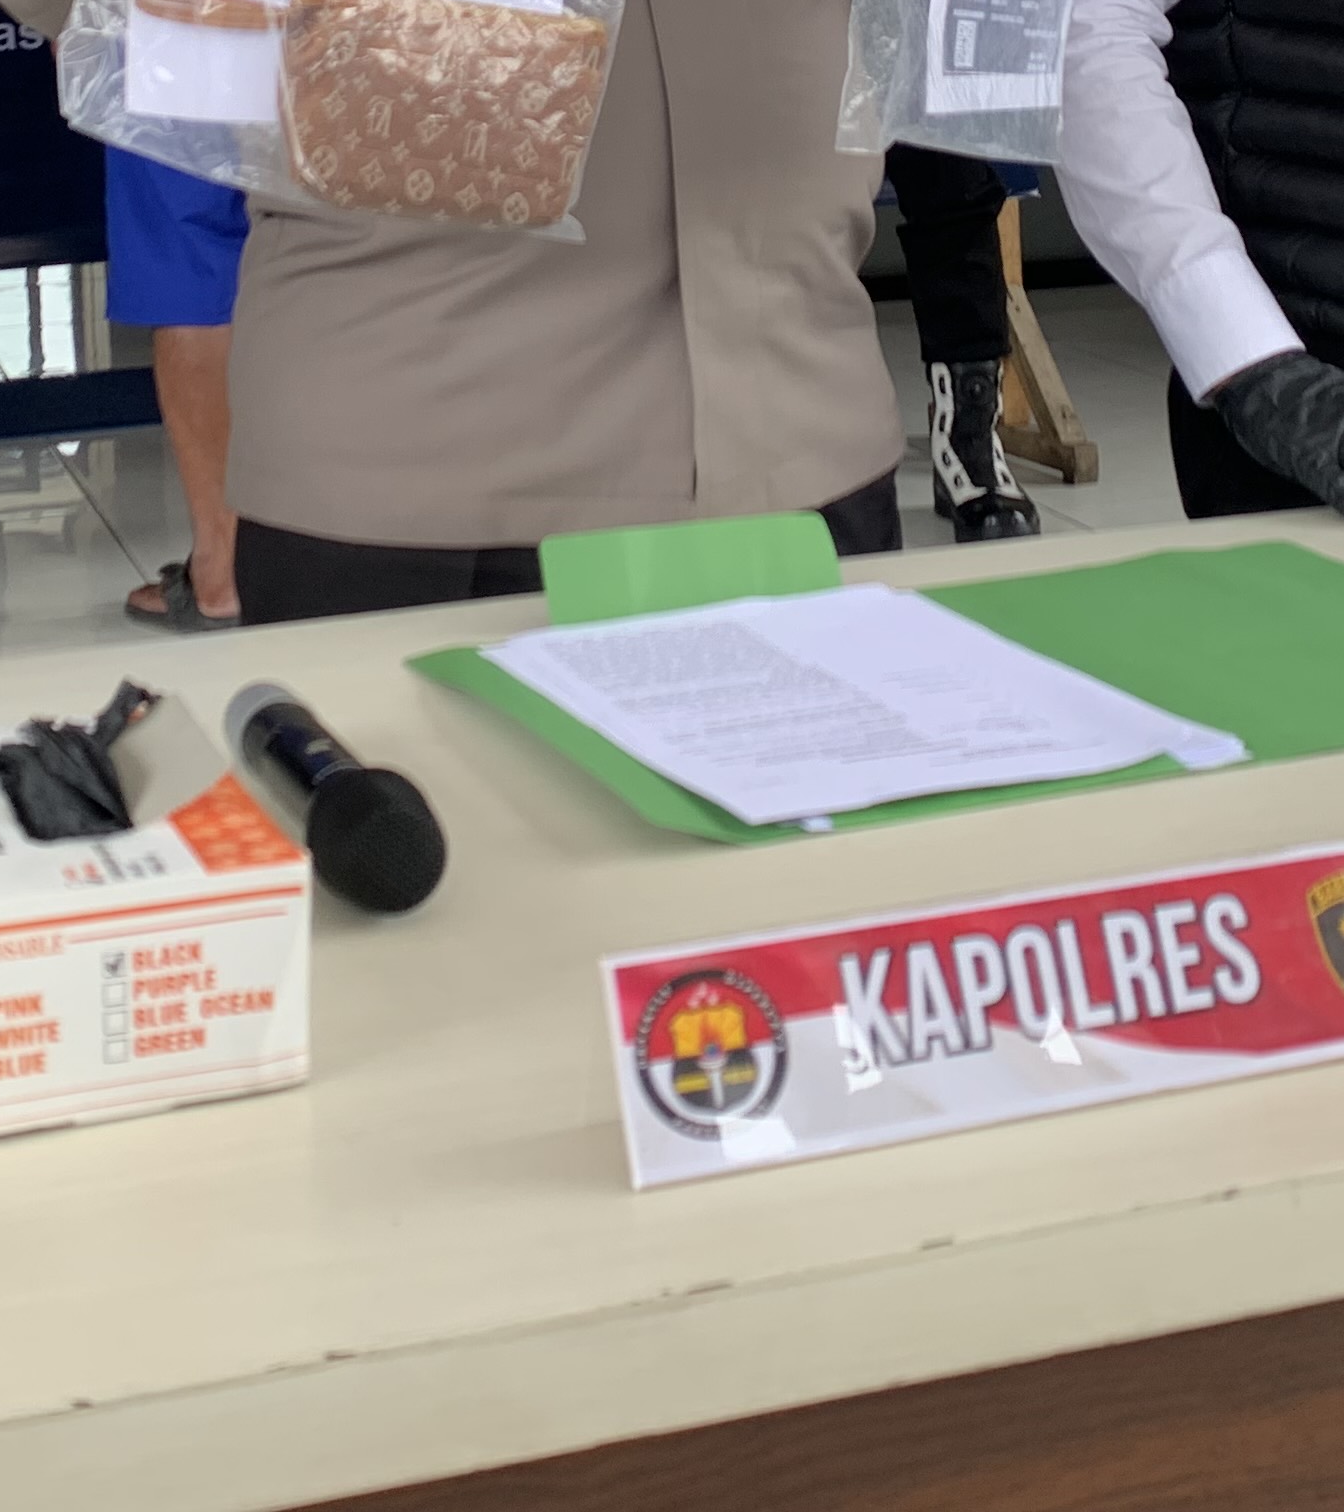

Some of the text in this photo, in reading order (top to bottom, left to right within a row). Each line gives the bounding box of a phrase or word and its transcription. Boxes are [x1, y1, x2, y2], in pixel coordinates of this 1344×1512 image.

[132, 942, 202, 973] BLACK
[132, 968, 217, 999] PURPLE
[839, 892, 1262, 1072] KAPOLRES
[133, 989, 275, 1029] BLUE OCEAN
[133, 1027, 207, 1058] GREEN
